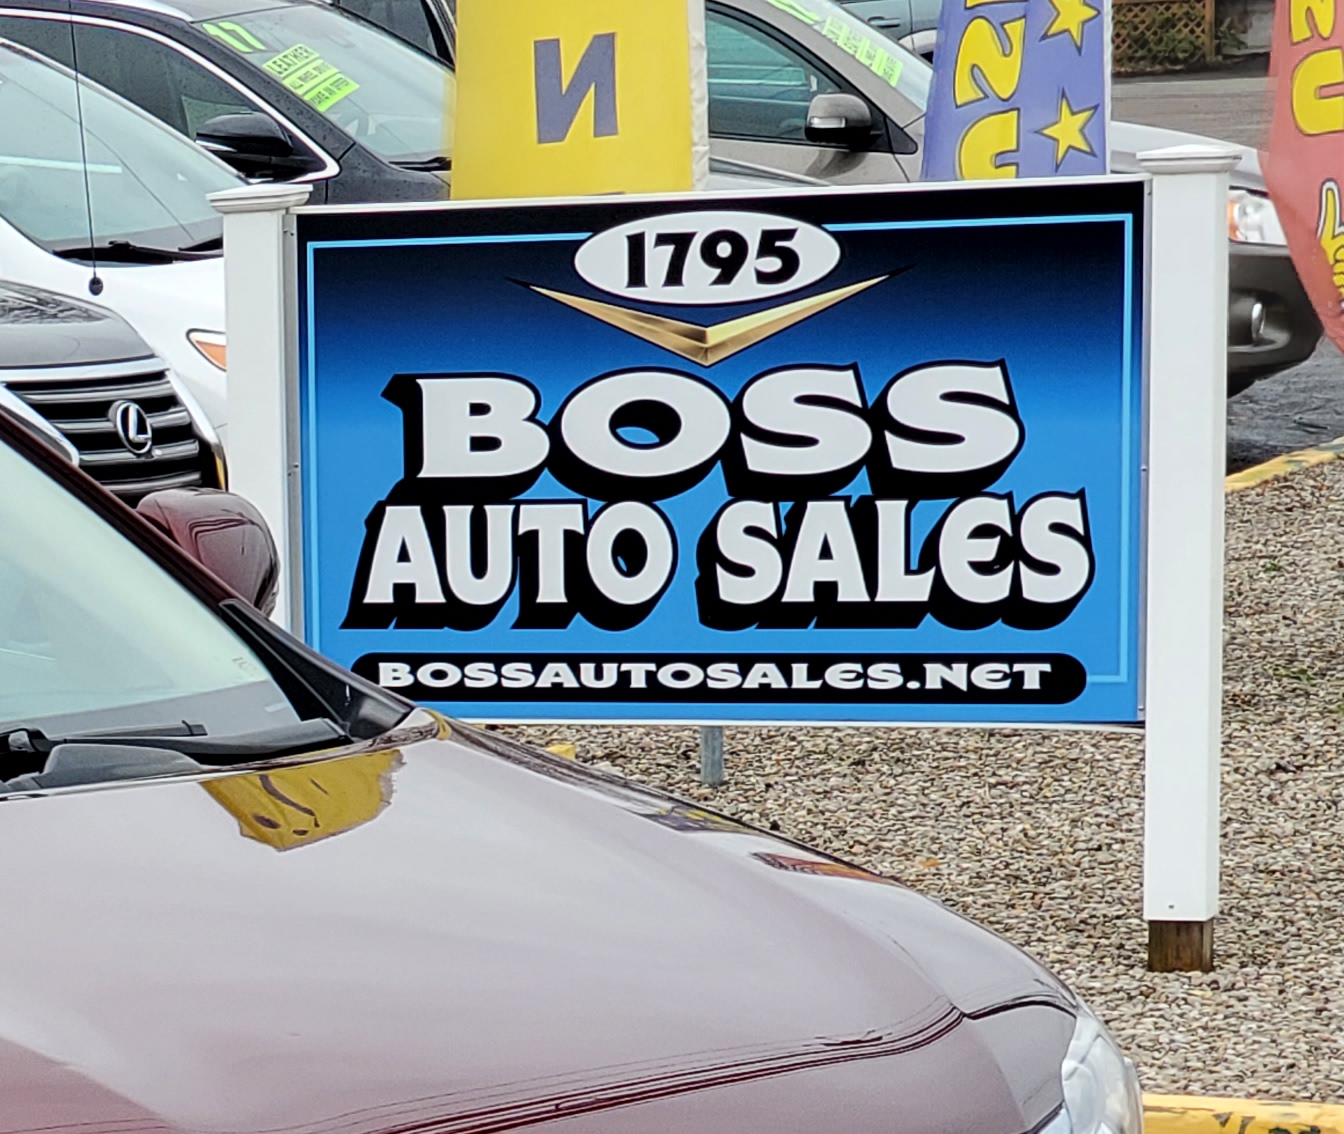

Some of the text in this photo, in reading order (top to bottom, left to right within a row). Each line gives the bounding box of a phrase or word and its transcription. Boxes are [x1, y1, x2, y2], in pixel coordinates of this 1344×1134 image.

[624, 227, 800, 288] 1795
[414, 364, 1023, 480] BOSS
[362, 491, 1094, 607] AUTO SALES
[378, 661, 1052, 693] BOSSAUTOSALES.NET
